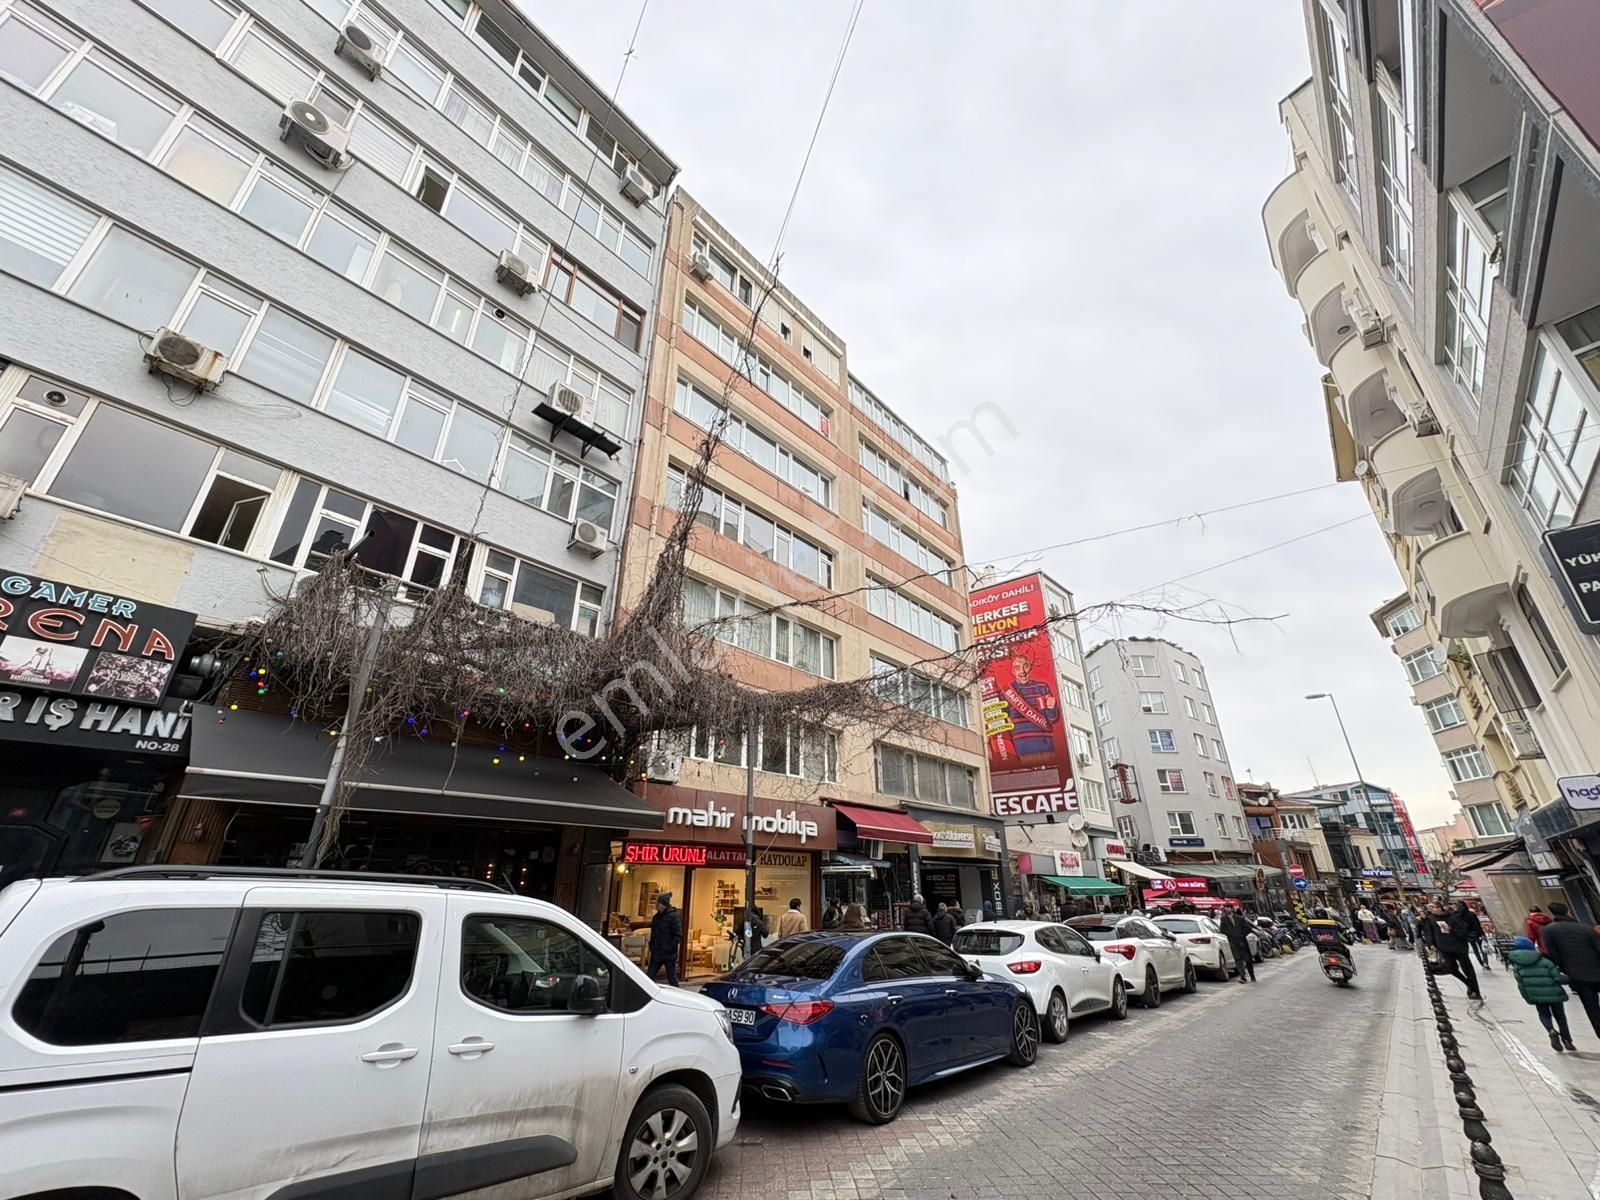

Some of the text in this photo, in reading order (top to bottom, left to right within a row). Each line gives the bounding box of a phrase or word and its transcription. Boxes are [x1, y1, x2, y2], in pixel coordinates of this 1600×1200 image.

[1, 575, 137, 619] GAMER
[1005, 688, 1027, 712] BARTU
[667, 801, 818, 844] mahir mobilya
[760, 854, 807, 866] RAYDOLAP
[744, 1011, 754, 1023] 90
